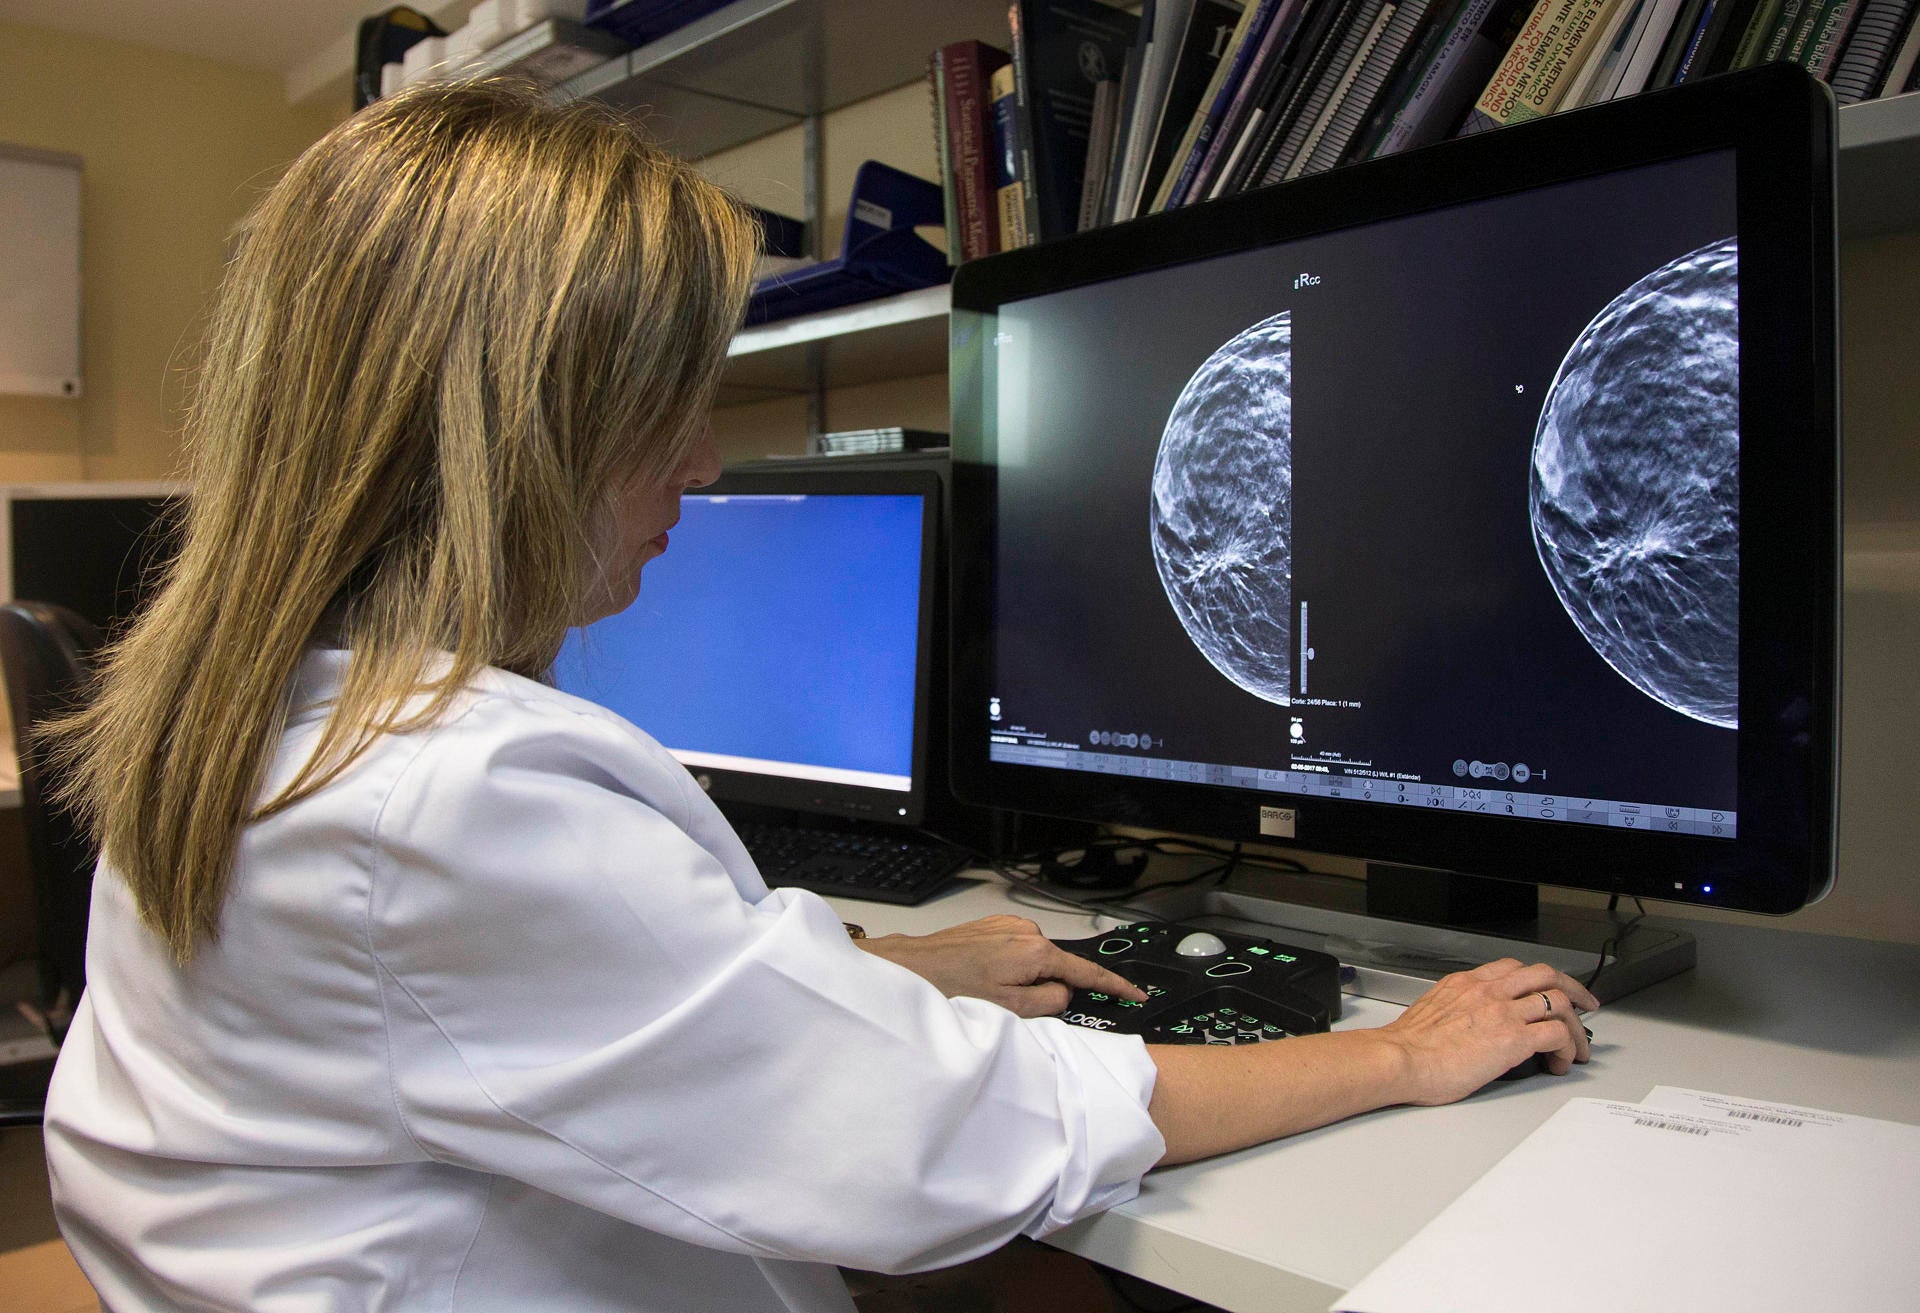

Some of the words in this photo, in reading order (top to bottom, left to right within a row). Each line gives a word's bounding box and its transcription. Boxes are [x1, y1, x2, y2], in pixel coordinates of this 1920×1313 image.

[1449, 27, 1462, 46] POR
[1460, 27, 1472, 42] EN
[1521, 0, 1551, 41] CTURAL
[1562, 10, 1584, 40] FLUID
[1563, 9, 1596, 59] ELEMENT
[1792, 18, 1815, 55] Clinical
[1819, 6, 1842, 44] Clinical
[1440, 47, 1451, 59] LA
[1526, 30, 1544, 54] FOR
[1527, 24, 1560, 73] ELEMENT
[1766, 26, 1788, 61] Clinical
[1806, 44, 1826, 74] Blood
[1415, 62, 1440, 100] IMAGEN
[1481, 44, 1524, 108] MECHANICS
[1505, 54, 1530, 87] SOLID
[1525, 43, 1563, 100] DYNAMICS
[1533, 58, 1567, 106] METHOD
[1490, 88, 1508, 113] AND
[1500, 72, 1532, 119] METHOD
[1261, 809, 1292, 821] BARCO
